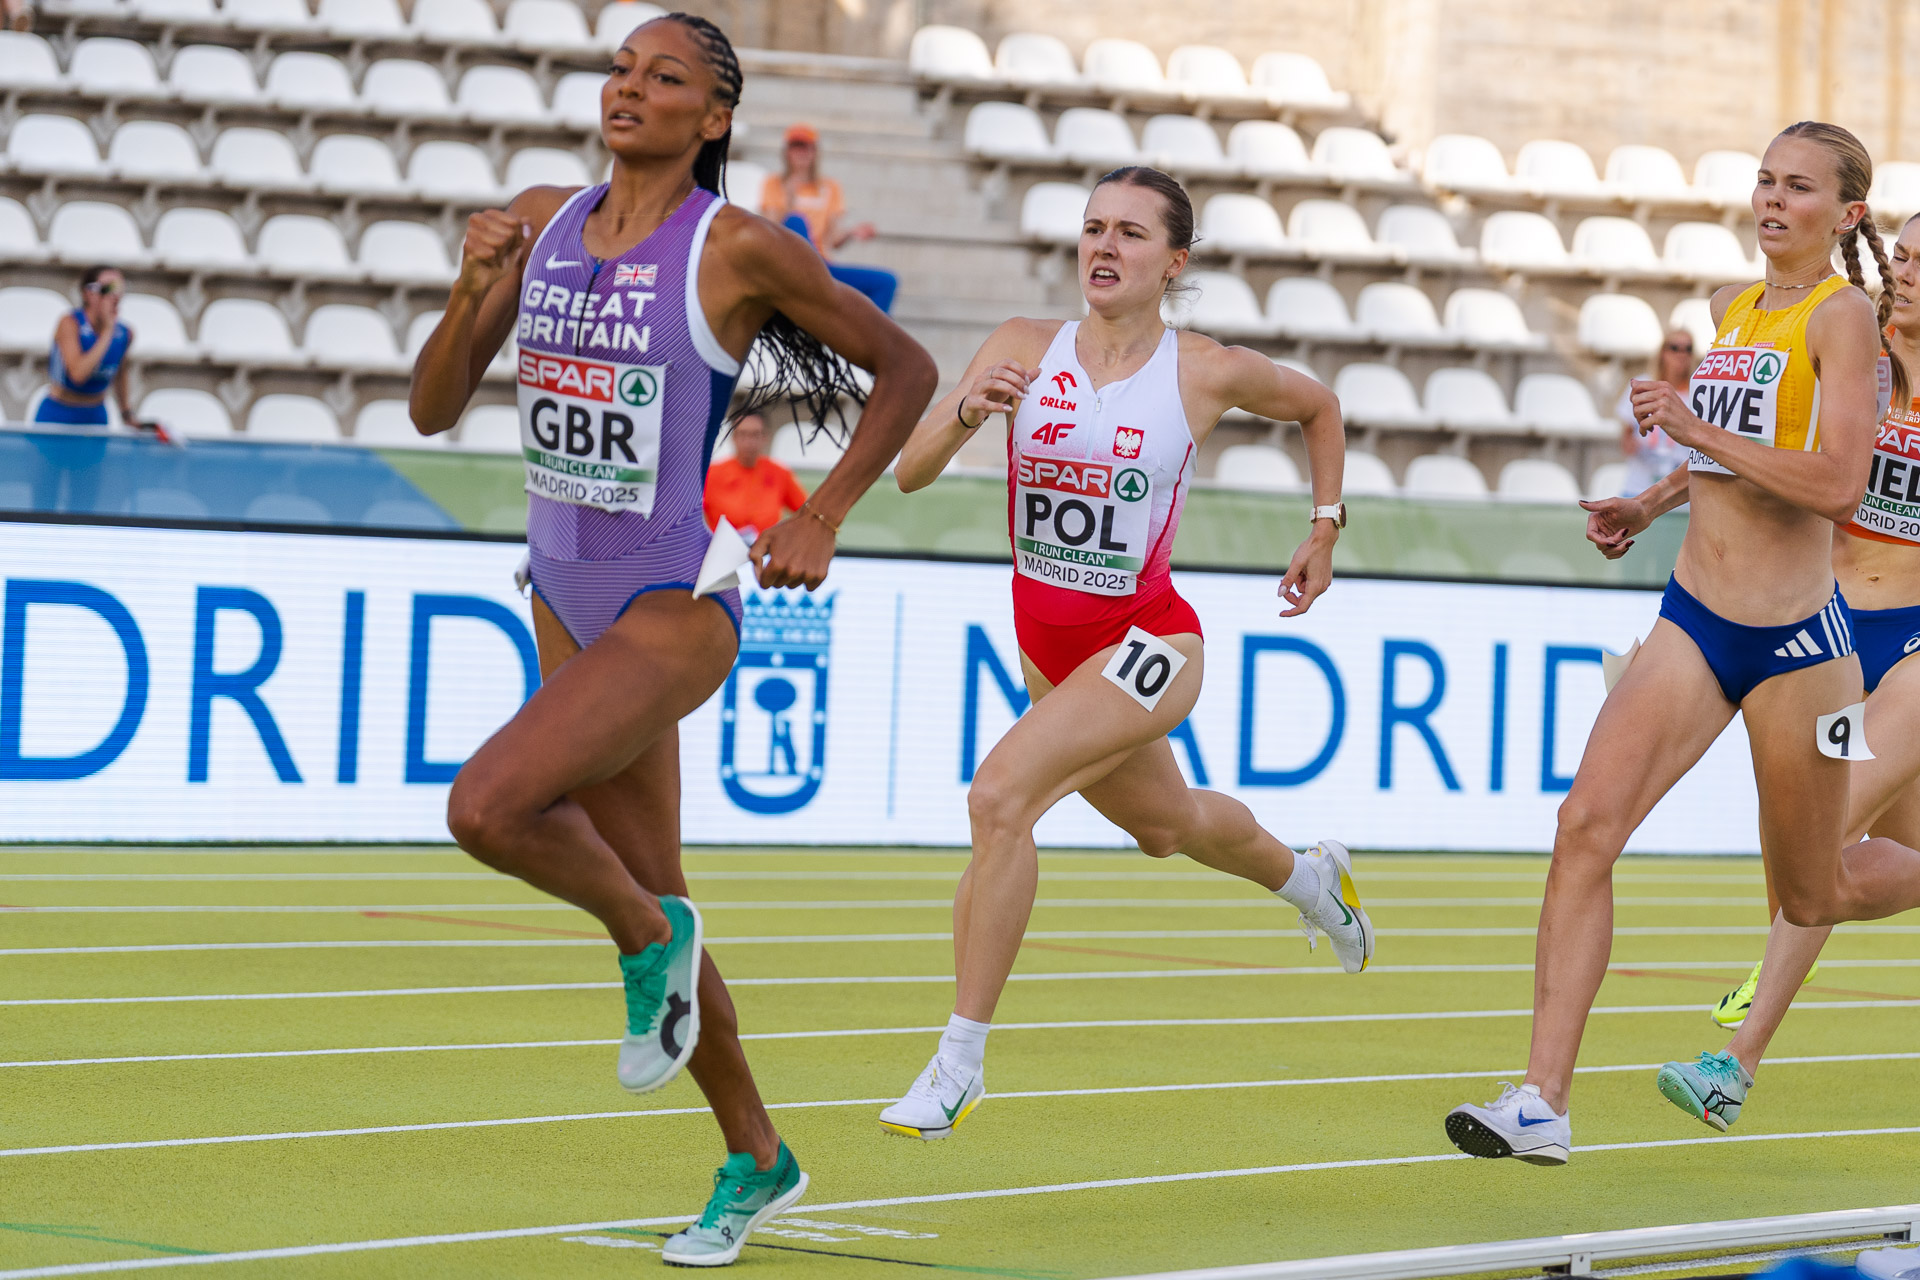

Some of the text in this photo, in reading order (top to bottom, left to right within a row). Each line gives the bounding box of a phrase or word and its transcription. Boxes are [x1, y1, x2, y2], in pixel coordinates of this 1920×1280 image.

[524, 279, 656, 319] GREAT
[519, 311, 651, 353] BRITAIN
[519, 356, 613, 399] SPAR
[1696, 353, 1752, 377] SPAR
[1040, 395, 1077, 412] ORLEN
[1692, 384, 1764, 435] SWE
[530, 397, 639, 464] GBR
[1031, 422, 1077, 445] 4F
[545, 454, 568, 472] RUN
[1018, 459, 1108, 494] SPAR
[529, 468, 639, 504] MADRID 2025
[1025, 493, 1127, 552] POL
[1856, 508, 1920, 536] DRID 20
[1038, 544, 1061, 559] RUN
[1024, 555, 1128, 590] MADRID 2025
[0, 577, 542, 786] DRID
[1115, 637, 1171, 698] 10
[1828, 715, 1851, 757] 9
